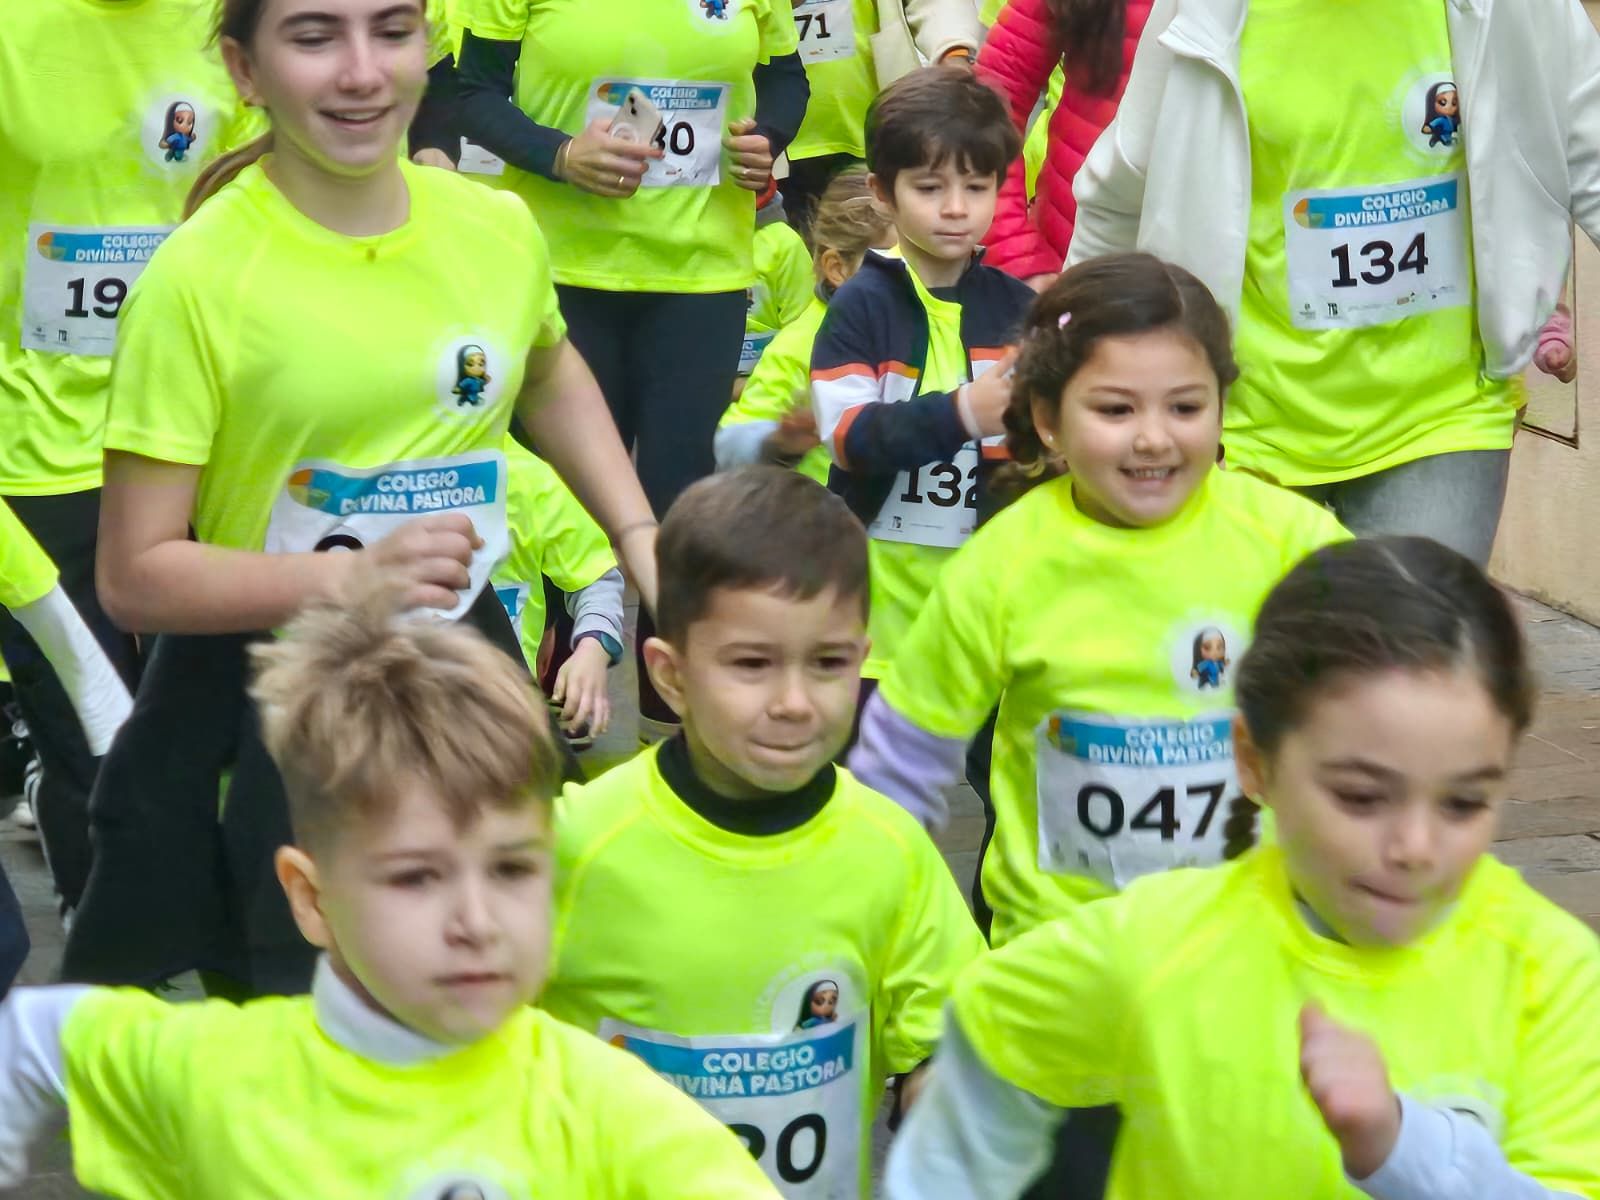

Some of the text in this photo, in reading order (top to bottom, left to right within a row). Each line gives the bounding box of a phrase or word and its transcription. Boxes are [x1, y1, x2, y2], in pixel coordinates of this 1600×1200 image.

[793, 12, 831, 41] 71
[1334, 198, 1449, 227] DIVINA PASTORA
[1362, 189, 1427, 210] COLEGIO
[75, 249, 124, 263] DIVINA
[1331, 232, 1429, 288] 134
[65, 278, 128, 319] 19
[377, 470, 459, 492] COLEGIO
[413, 485, 486, 511] PASTORA
[1125, 724, 1214, 747] COLEGIO
[1088, 743, 1157, 765] DIVINA
[1077, 780, 1226, 841] 047
[702, 1045, 815, 1073] COLEGIO
[751, 1056, 845, 1095] PASTORA
